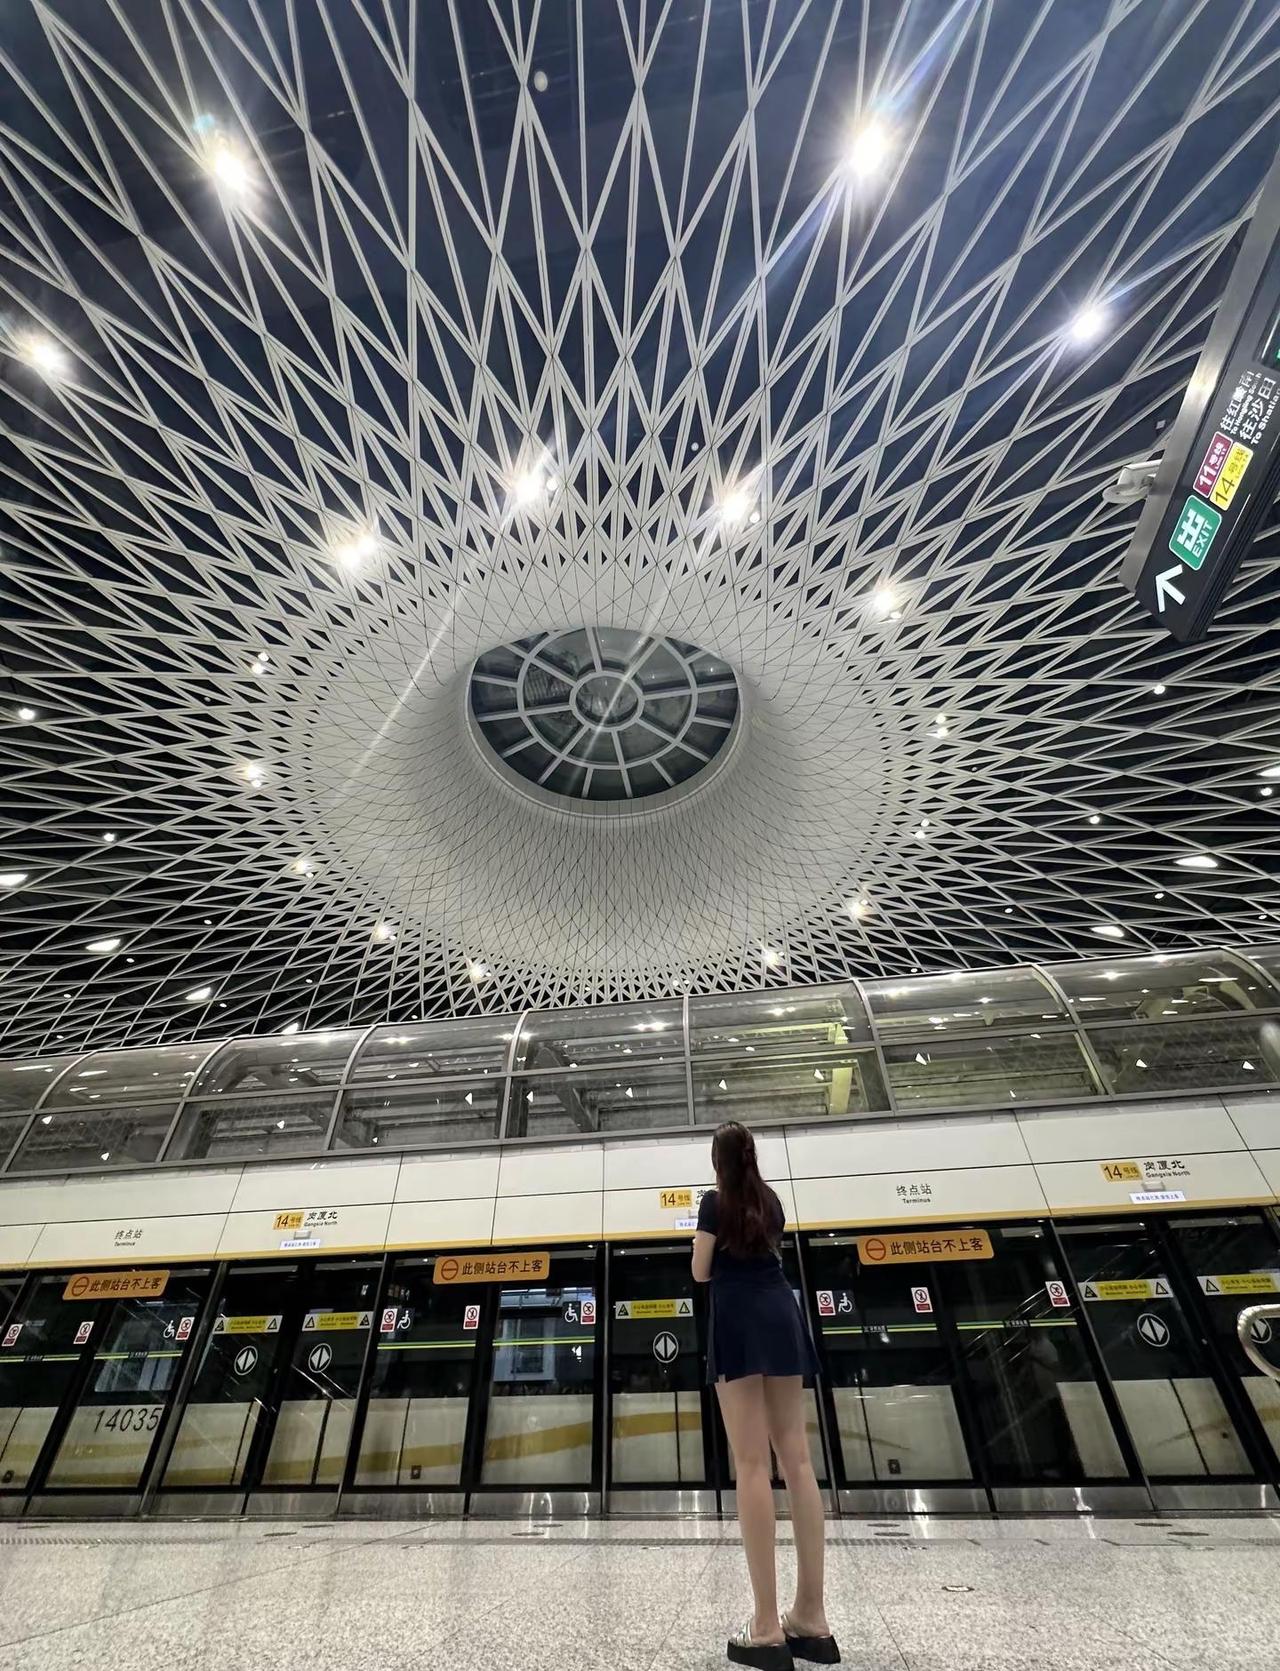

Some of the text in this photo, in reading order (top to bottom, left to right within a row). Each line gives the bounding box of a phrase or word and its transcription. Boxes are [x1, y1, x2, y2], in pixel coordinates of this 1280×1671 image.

[1249, 373, 1262, 394] Soh
[1240, 377, 1276, 440] 往沙田
[1251, 432, 1262, 445] To
[1192, 519, 1213, 558] EXIT
[896, 1184, 932, 1196] 终点站
[114, 1229, 142, 1240] 终点站
[890, 1237, 983, 1255] 此侧站台不上客
[462, 1260, 542, 1275] 此侧站台不上客
[89, 1278, 162, 1292] 此侧站台不上客
[94, 1408, 163, 1434] 14035
